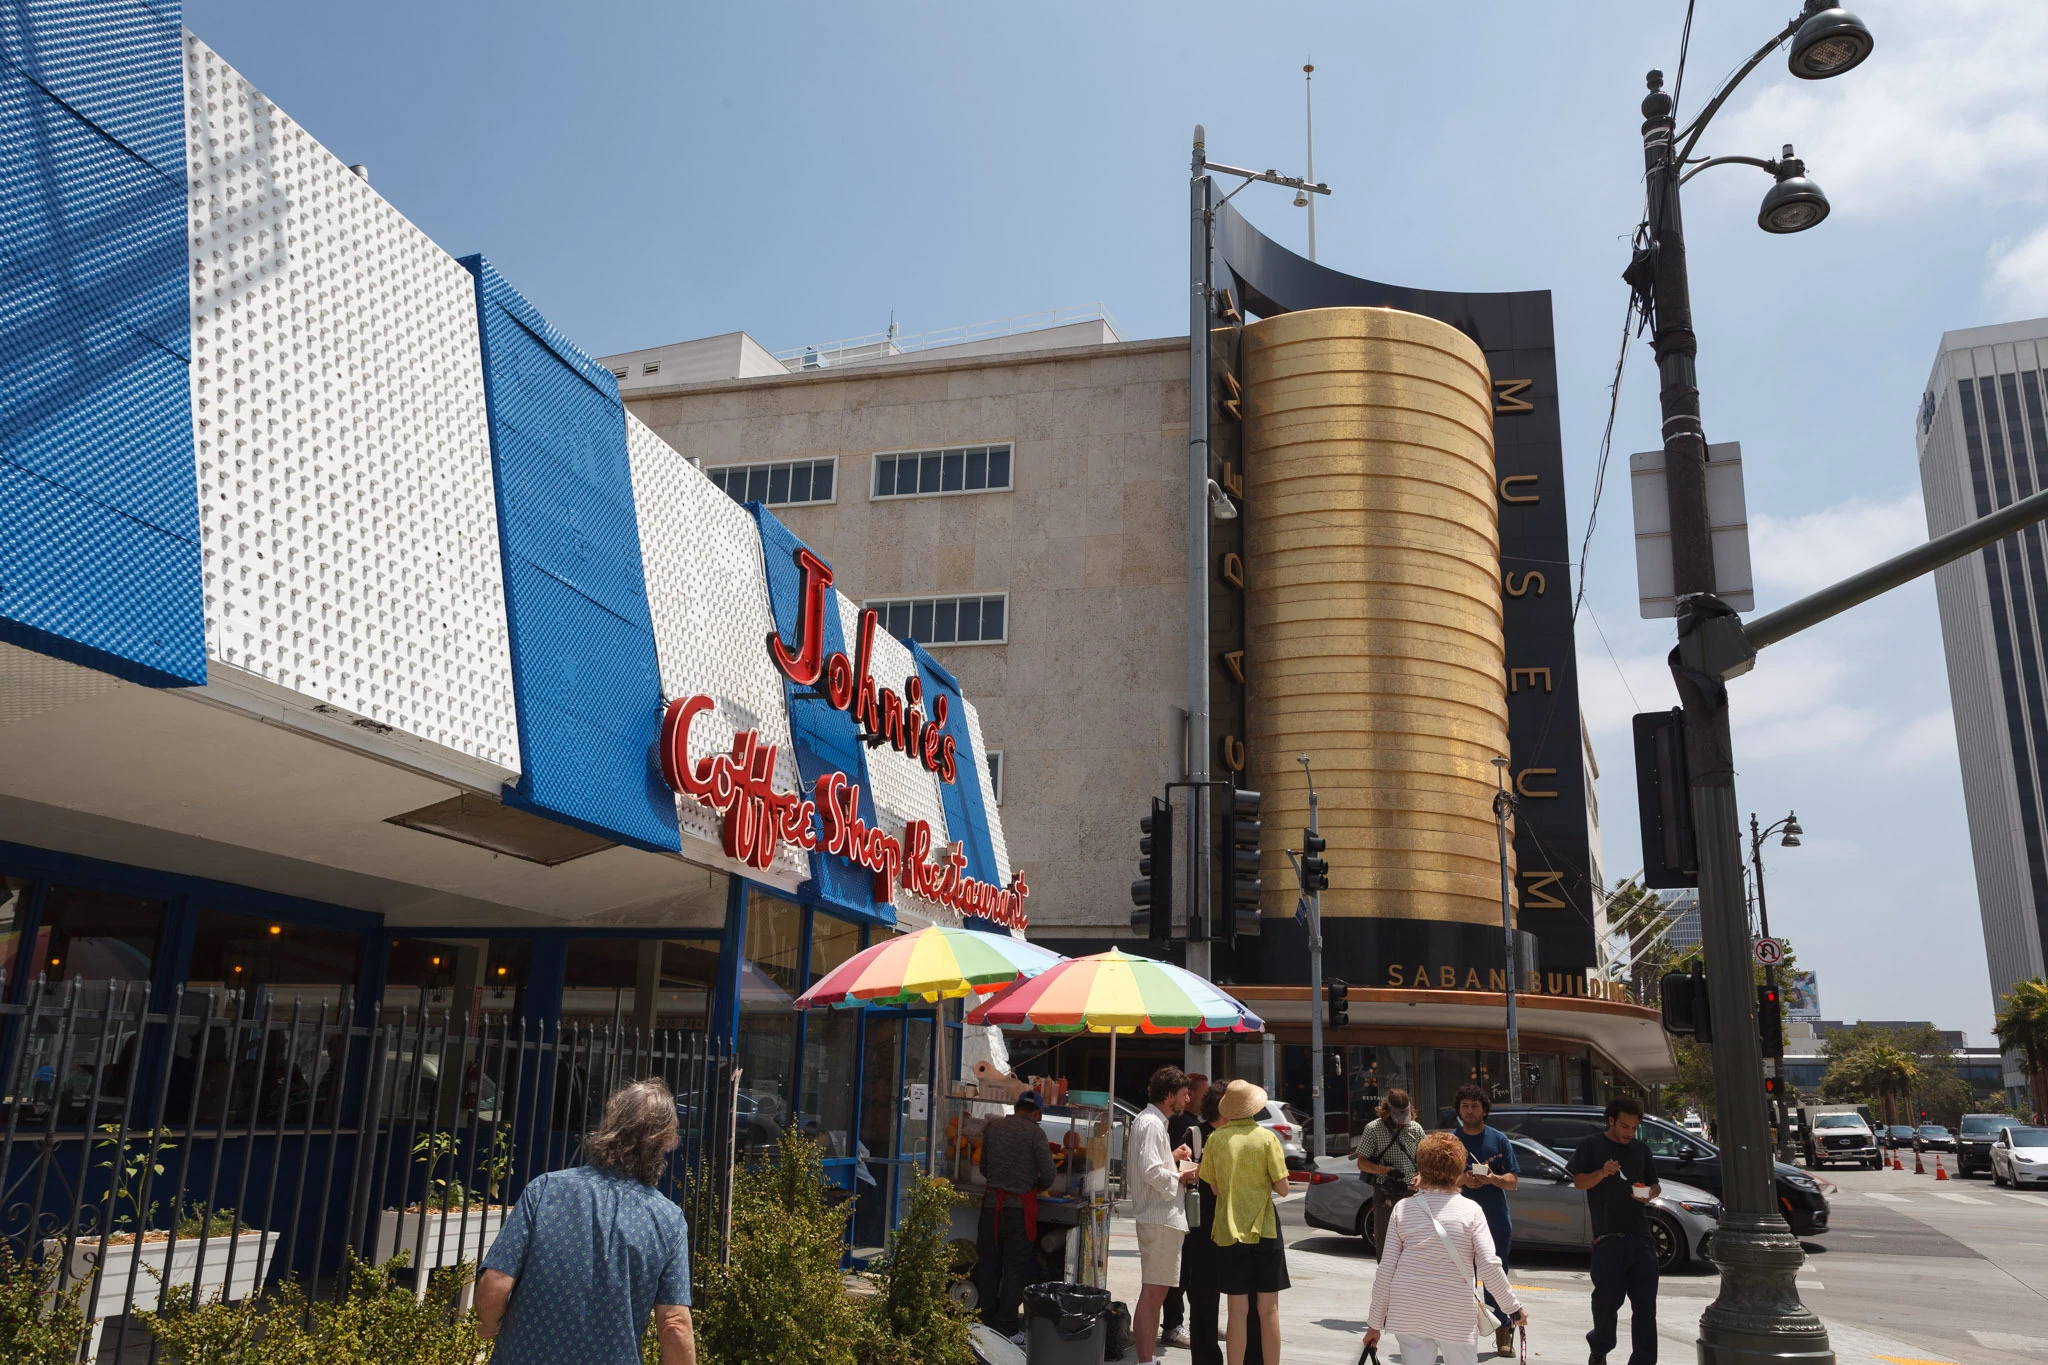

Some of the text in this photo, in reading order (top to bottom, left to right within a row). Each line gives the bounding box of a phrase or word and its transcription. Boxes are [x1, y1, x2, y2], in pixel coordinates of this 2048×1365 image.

[1216, 288, 1245, 772] CADEMY
[1494, 378, 1566, 911] MUSEUM
[766, 547, 957, 785] Johnie's
[660, 693, 1030, 931] Coffee Shop Restaurant
[1387, 963, 1627, 1003] SABAN BUILDING
